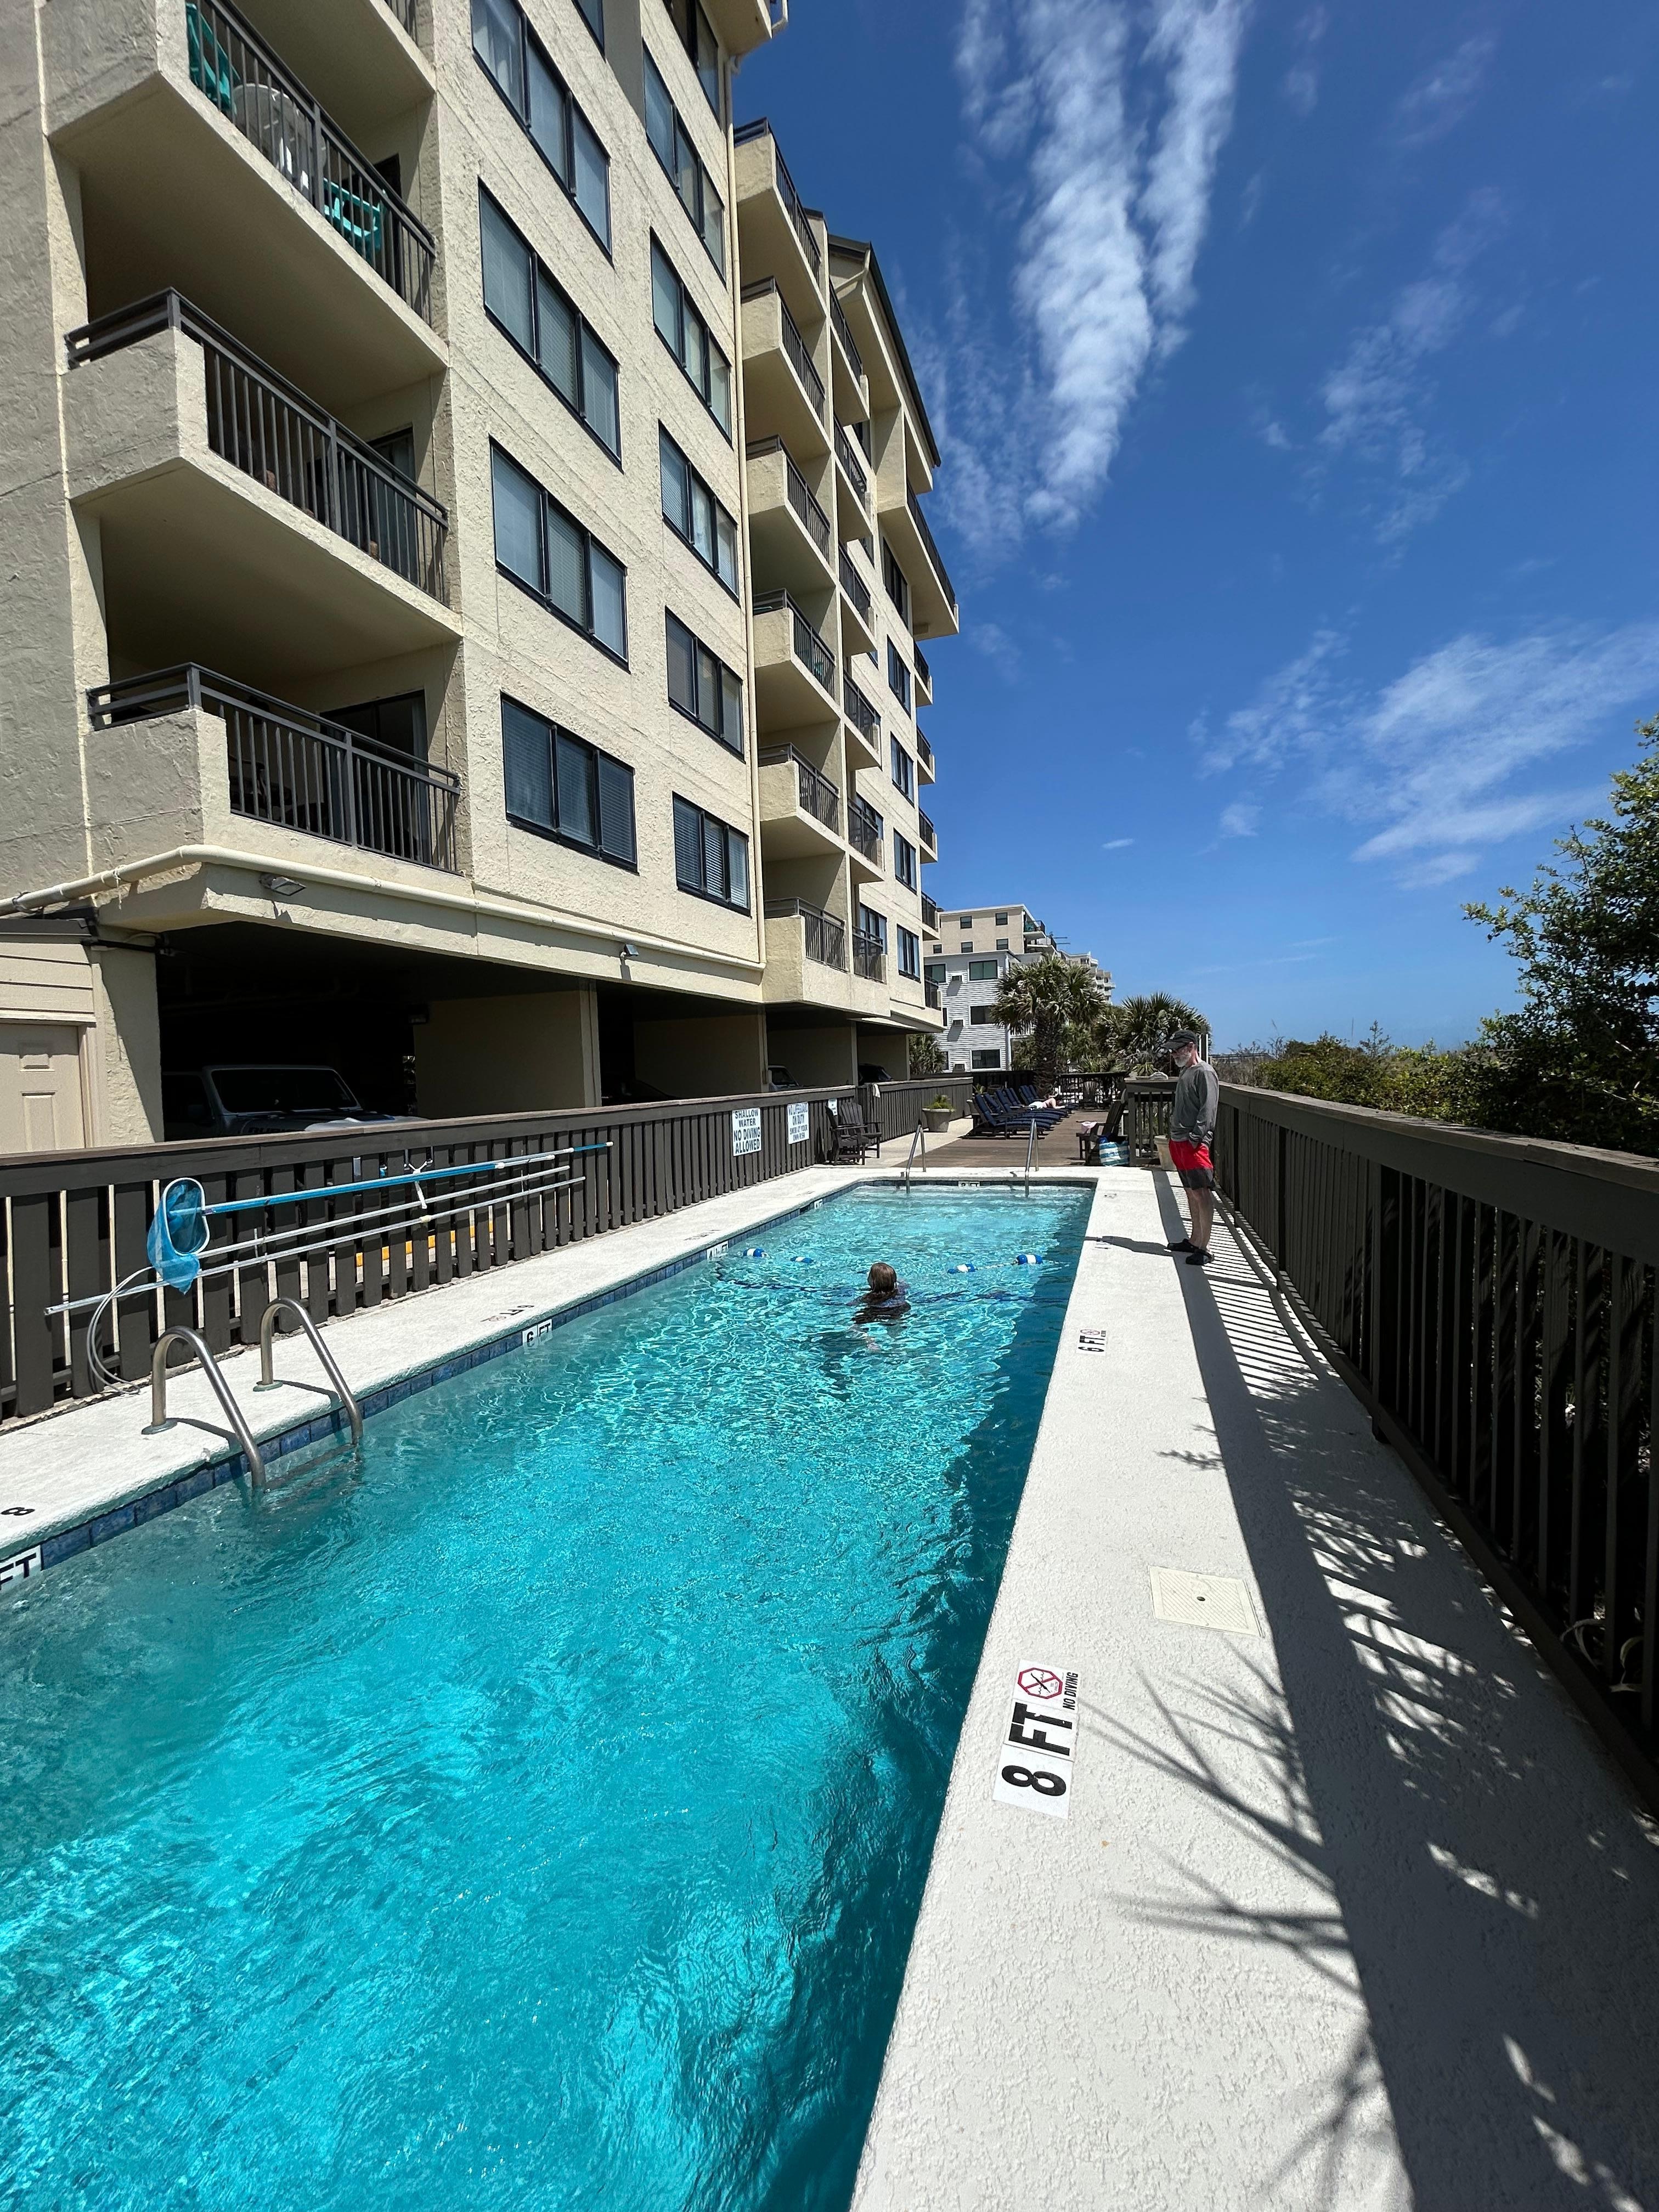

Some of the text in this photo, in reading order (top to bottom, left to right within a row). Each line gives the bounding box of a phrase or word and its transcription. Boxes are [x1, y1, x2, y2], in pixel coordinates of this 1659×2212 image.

[735, 1109, 758, 1119] SHALLOW
[739, 1118, 756, 1127] WATER
[733, 1127, 760, 1142] NO DIVING
[735, 1138, 760, 1154] ALLOWED
[539, 1323, 551, 1337] FT
[1079, 1335, 1105, 1346] FT
[1, 1507, 35, 1516] 8
[0, 1553, 36, 1591] FT
[1063, 1672, 1079, 1710] NO DIVING
[1002, 1702, 1073, 1796] 8 FT
